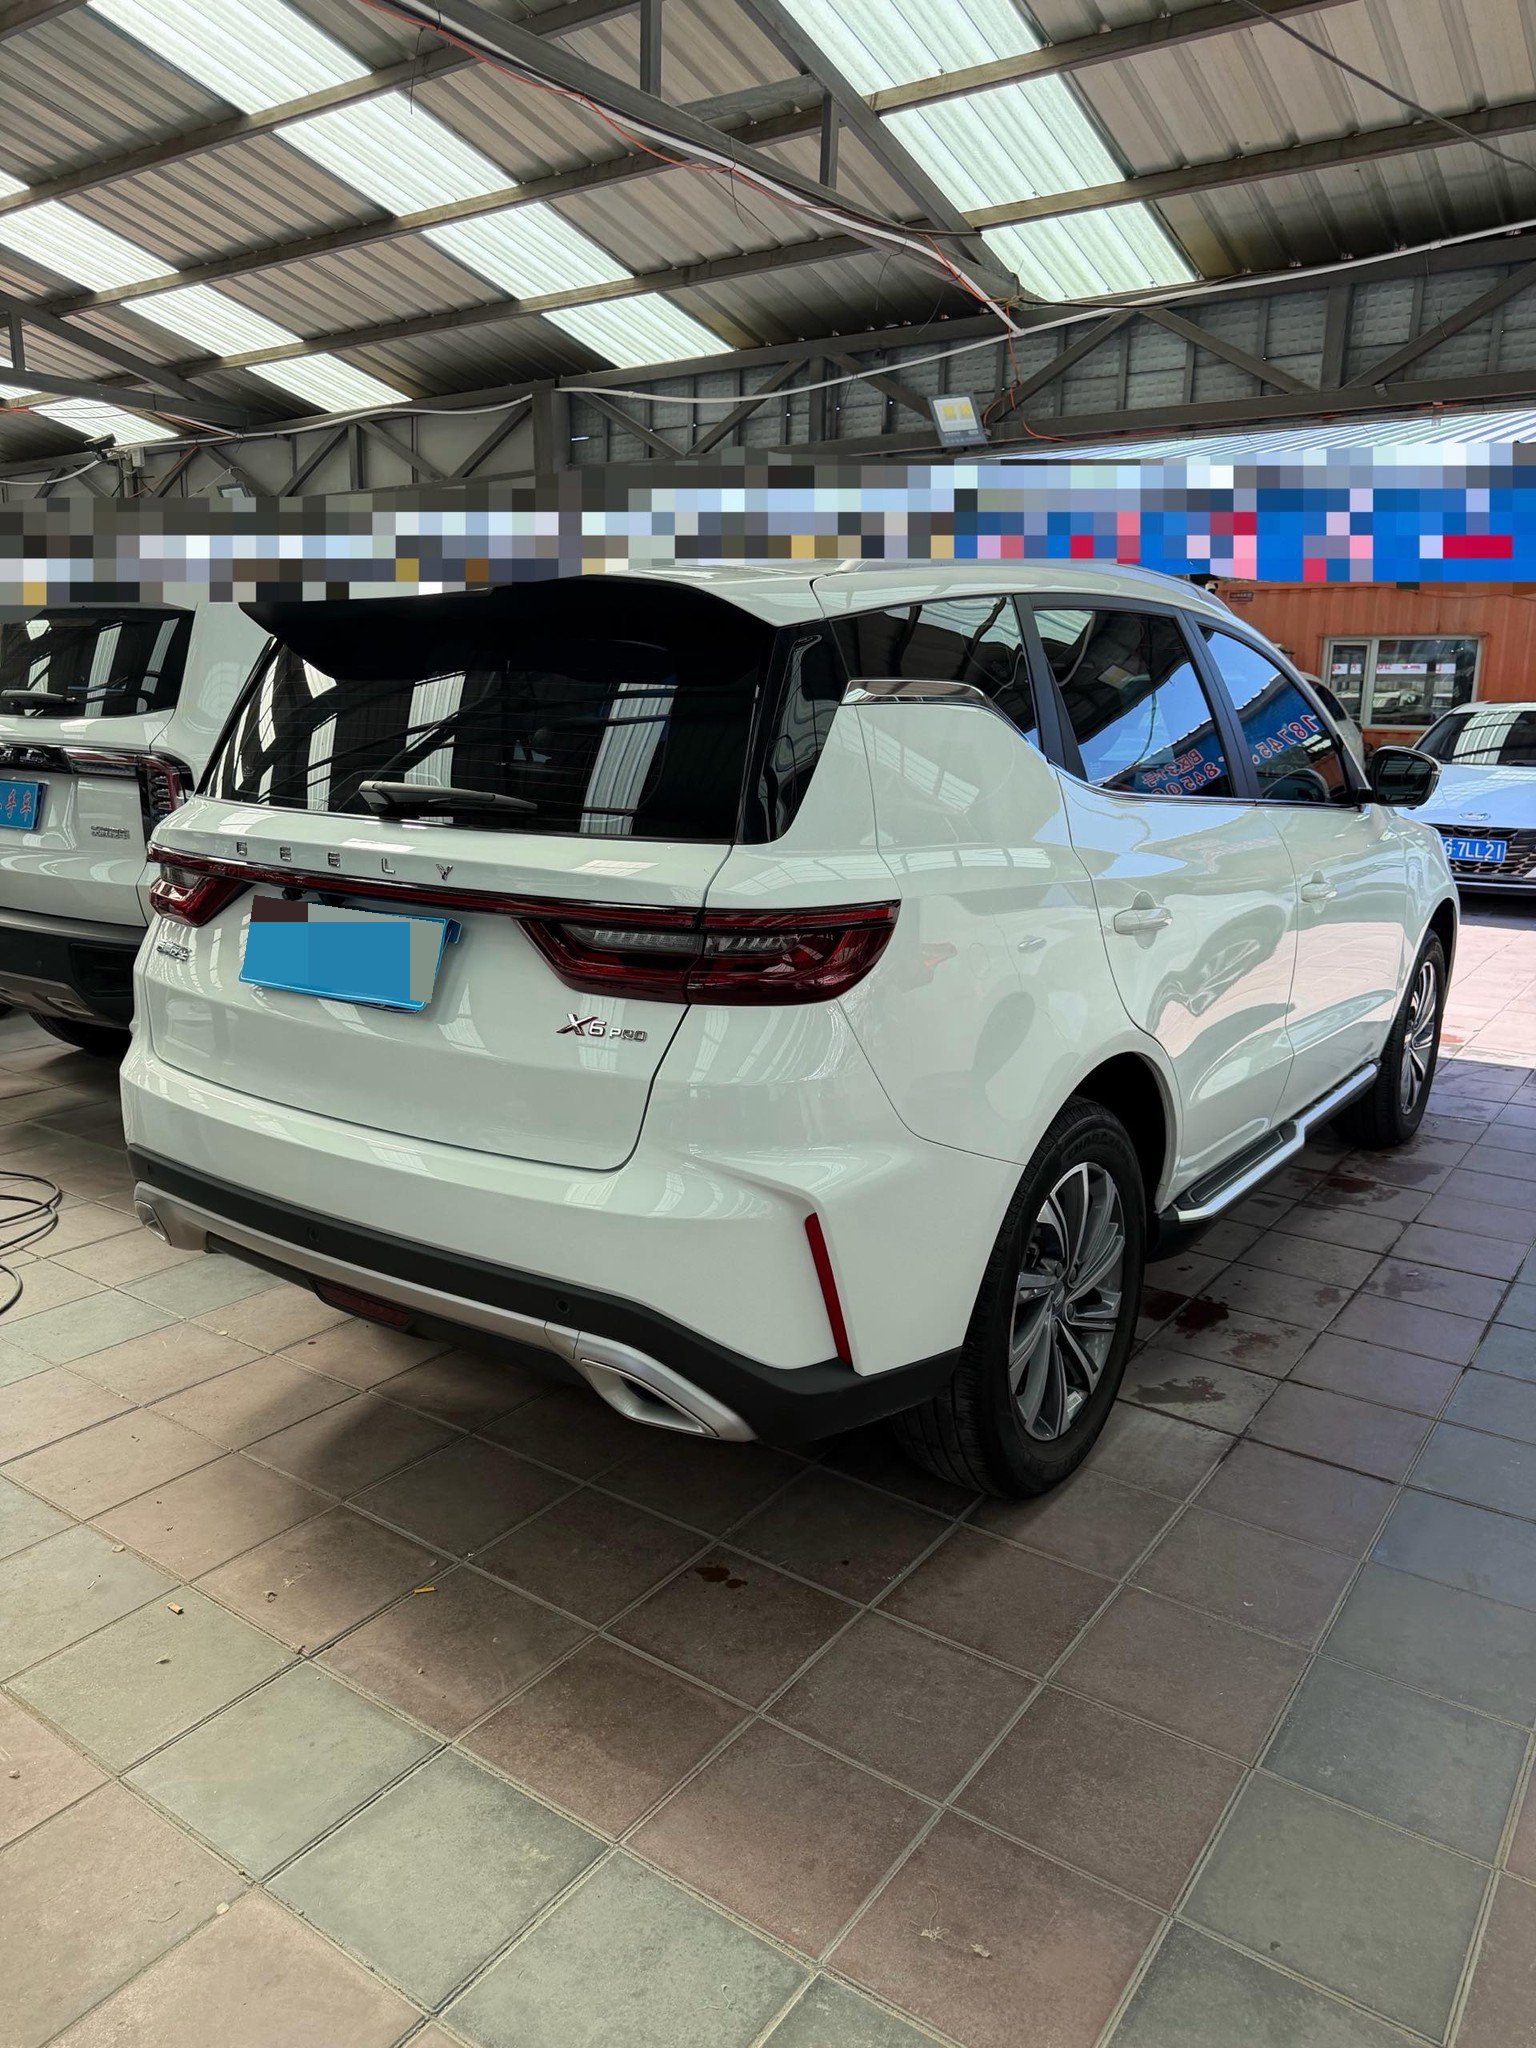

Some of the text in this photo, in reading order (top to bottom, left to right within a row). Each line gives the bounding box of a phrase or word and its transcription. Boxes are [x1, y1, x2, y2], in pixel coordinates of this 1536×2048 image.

[0, 786, 32, 823] 手车
[236, 841, 454, 882] GEELY
[556, 1012, 648, 1042] X6 PRO
